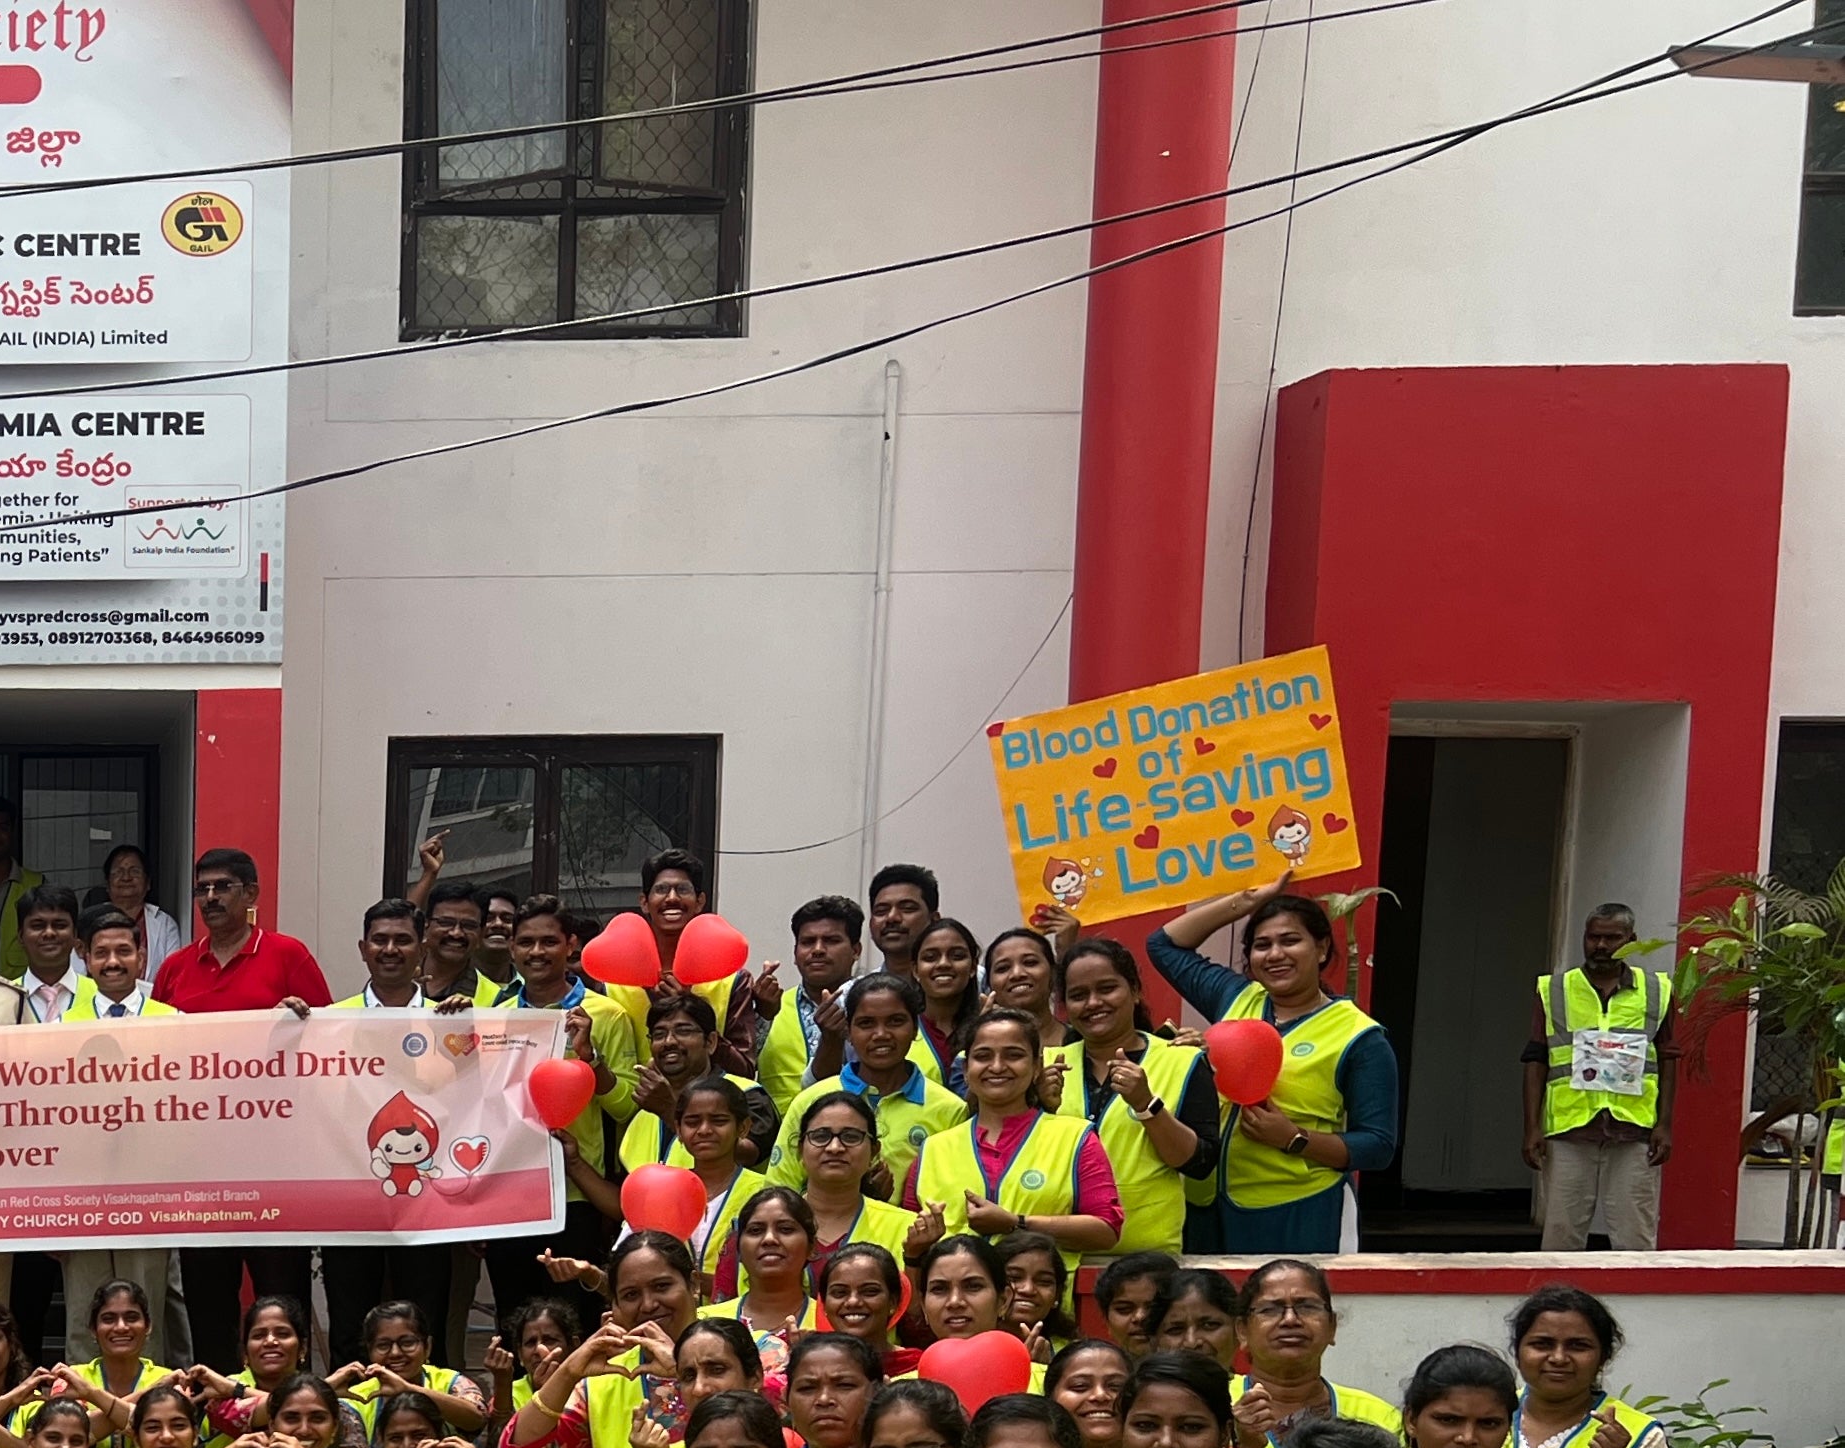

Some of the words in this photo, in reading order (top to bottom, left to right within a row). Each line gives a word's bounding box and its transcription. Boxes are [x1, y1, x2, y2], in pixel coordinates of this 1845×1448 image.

[6, 126, 82, 168] జిల్లా
[13, 232, 141, 257] CENTRE
[69, 275, 155, 305] సెంటర్
[33, 331, 96, 349] (INDIA)
[101, 330, 168, 345] Limited
[71, 411, 206, 437] CENTRE
[56, 448, 132, 486] కేంద్రం
[55, 492, 79, 506] for
[132, 546, 162, 555] Sankalp
[47, 632, 158, 647] 08912703368,
[161, 631, 265, 645] 8464966099
[1002, 711, 1120, 770] Blood
[1127, 674, 1320, 745] Donation
[1138, 739, 1183, 780] of
[1115, 832, 1255, 895] Love
[189, 1051, 286, 1081] Blood
[296, 1049, 385, 1078] Drive
[154, 1096, 209, 1122] the
[217, 1094, 293, 1120] Love
[10, 1196, 29, 1208] Red
[33, 1195, 60, 1207] Cross
[64, 1195, 100, 1207] Society
[103, 1192, 181, 1206] Visakhapatnam
[184, 1190, 220, 1202] District
[223, 1189, 260, 1201] Branch
[13, 1212, 79, 1227] CHURCH
[83, 1212, 103, 1226] OF
[108, 1211, 143, 1225] GOD
[150, 1209, 257, 1224] Visakhapatnam,
[260, 1208, 280, 1220] AP
